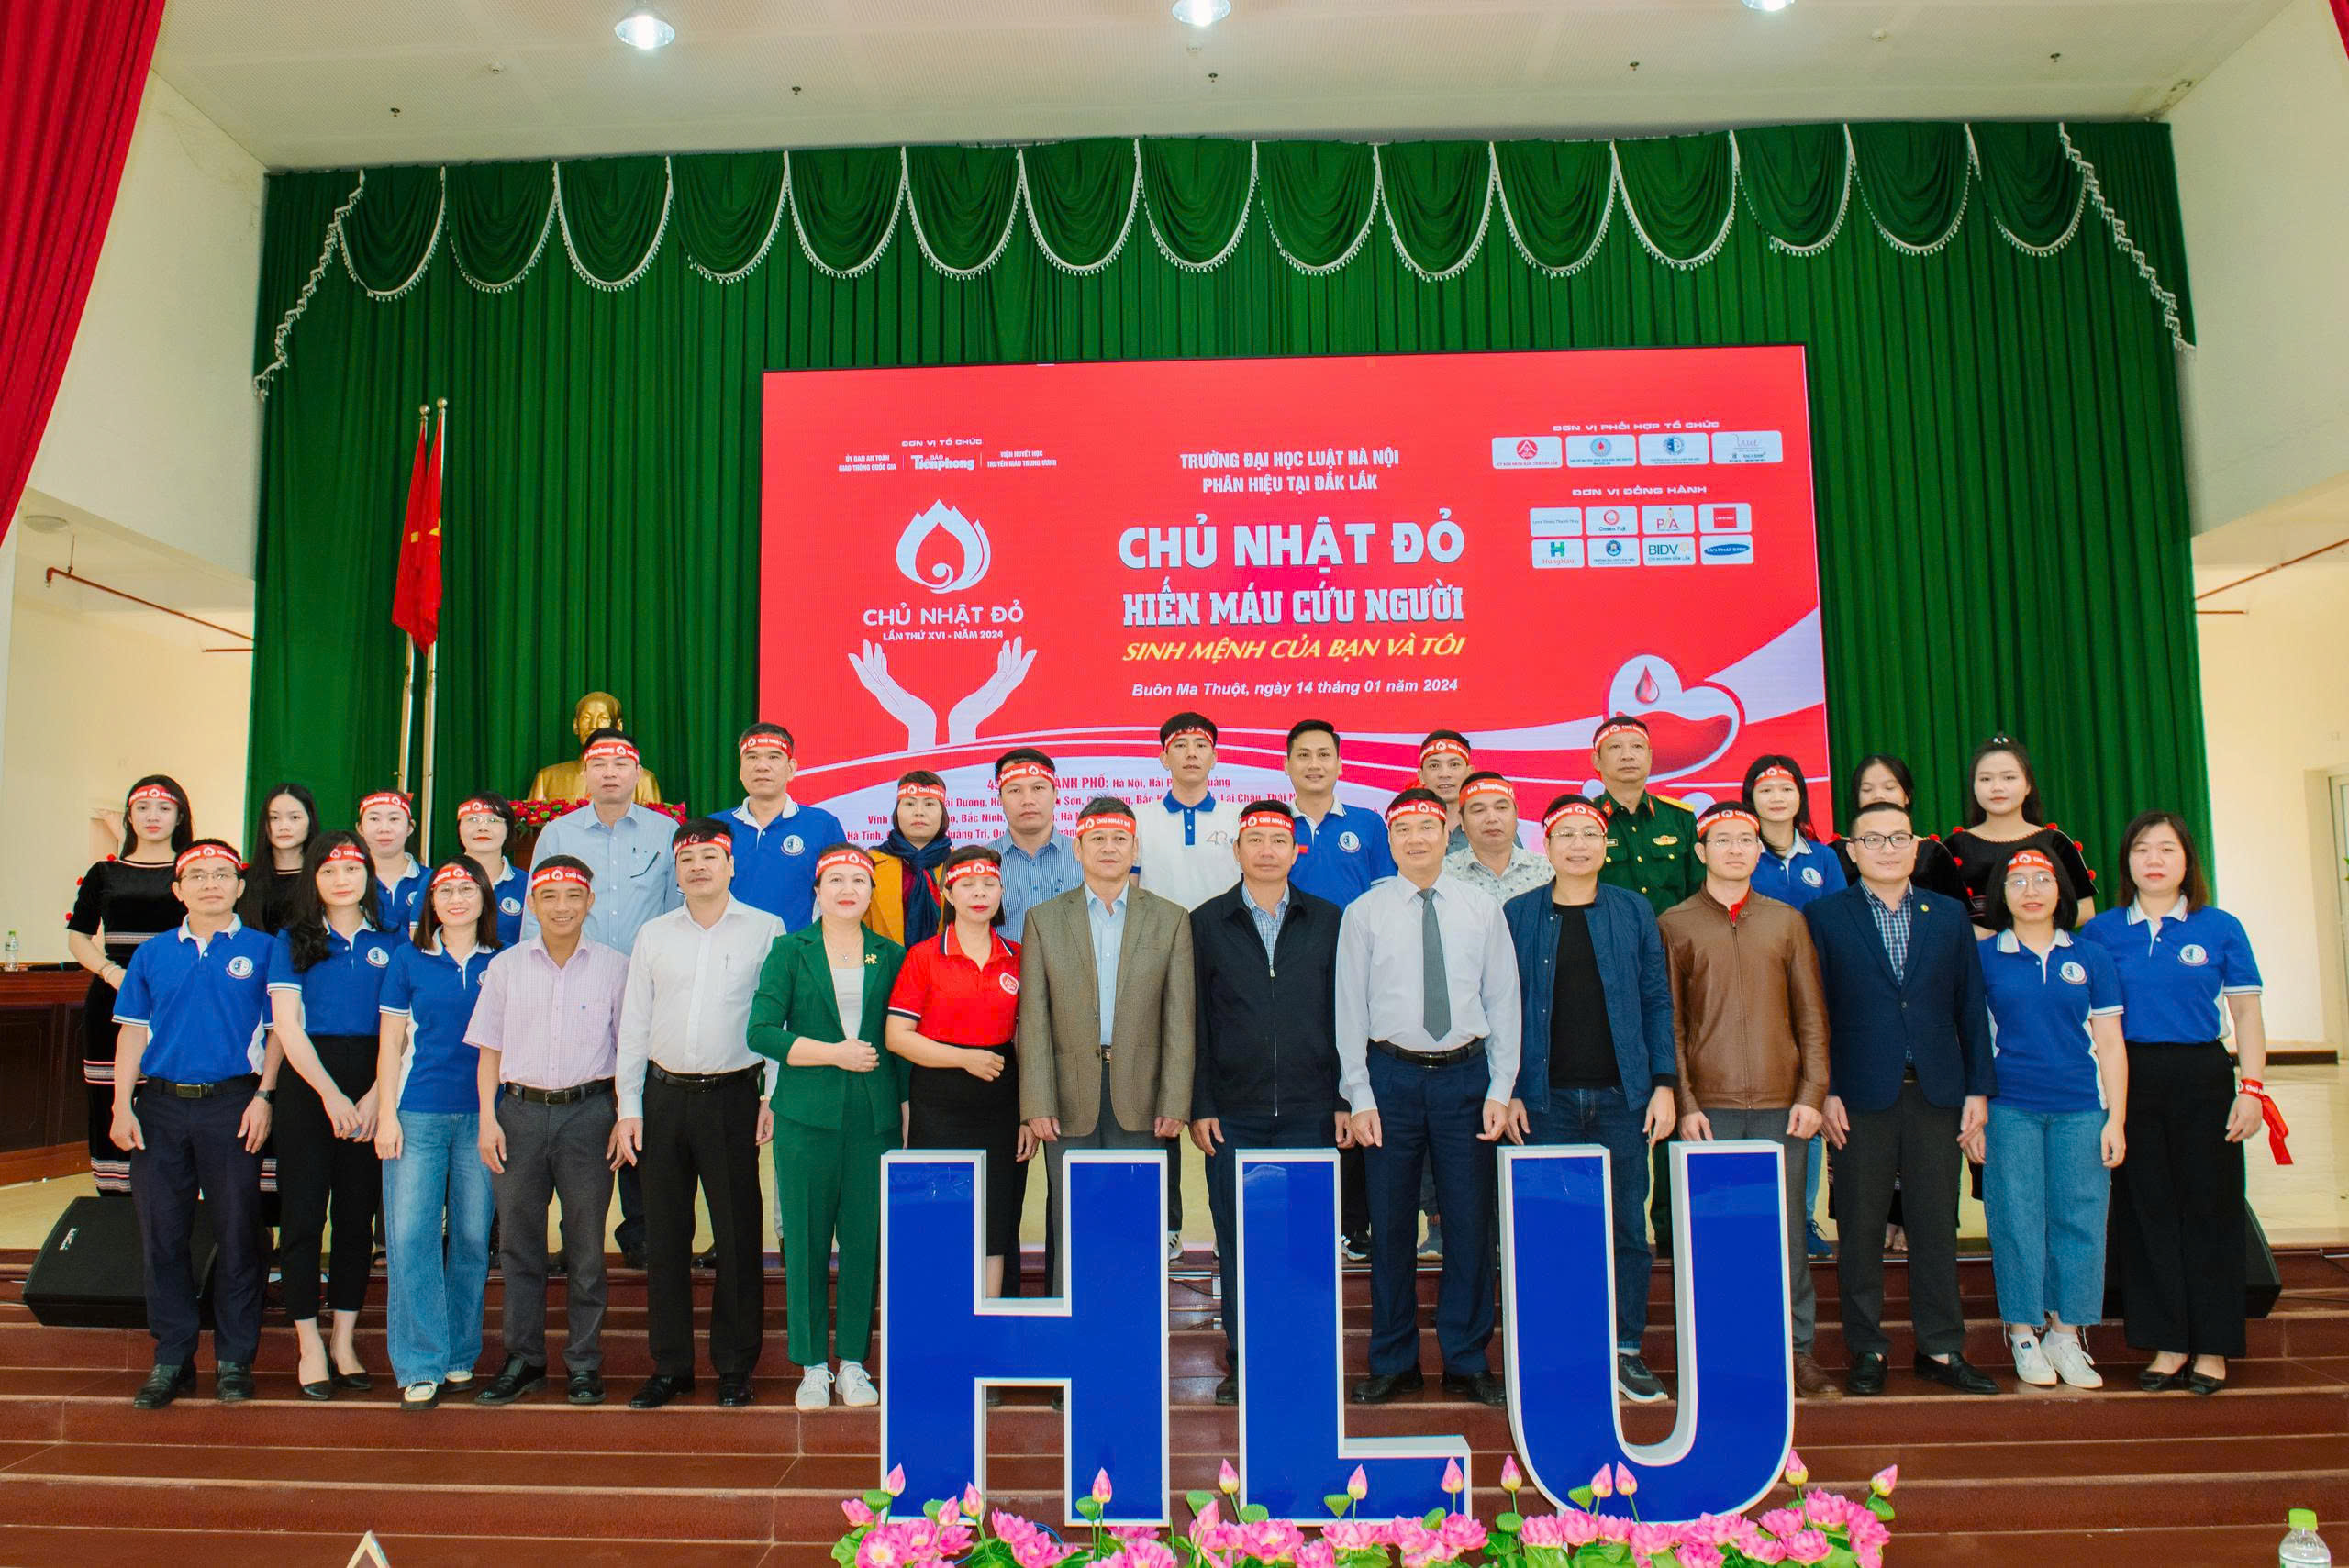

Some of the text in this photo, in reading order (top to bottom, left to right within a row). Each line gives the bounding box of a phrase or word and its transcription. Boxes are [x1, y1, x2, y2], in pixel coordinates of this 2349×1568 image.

[1180, 448, 1399, 471] TRƯỜNG ĐẠI HỌC LUẬT HÀ NỘI
[1203, 470, 1378, 495] PHÂN HIỆU TẠI ĐẮK LẮK
[1607, 488, 1620, 496] VỊ
[1666, 484, 1707, 494] HÀNH
[1119, 508, 1465, 573] CHỦ NHẬT ĐỎ
[1648, 544, 1679, 555] BIDV
[1122, 576, 1464, 627] HIẾN MÁU CỨU NGƯỜI
[863, 599, 1024, 628] CHỦ NHẬT ĐỎ
[883, 629, 903, 641] LẦN
[905, 629, 926, 640] THỨ
[928, 630, 945, 639] XVI
[953, 628, 978, 639] NĂM
[980, 630, 1004, 639] 2024
[1122, 632, 1467, 663] SINH MỆNH CỦA BẠN VÀ TÔI
[1131, 679, 1458, 698] Buôn Ma Thuột, ngày 14 tháng 01 năm 2024
[1055, 775, 1078, 789] ÀNH
[1082, 773, 1108, 790] PHỐ:
[1113, 778, 1125, 787] Hà
[1128, 778, 1145, 790] Nội,
[1208, 777, 1230, 789] uảng
[981, 813, 1006, 823] Ninh,
[881, 1140, 1796, 1526] HLU
